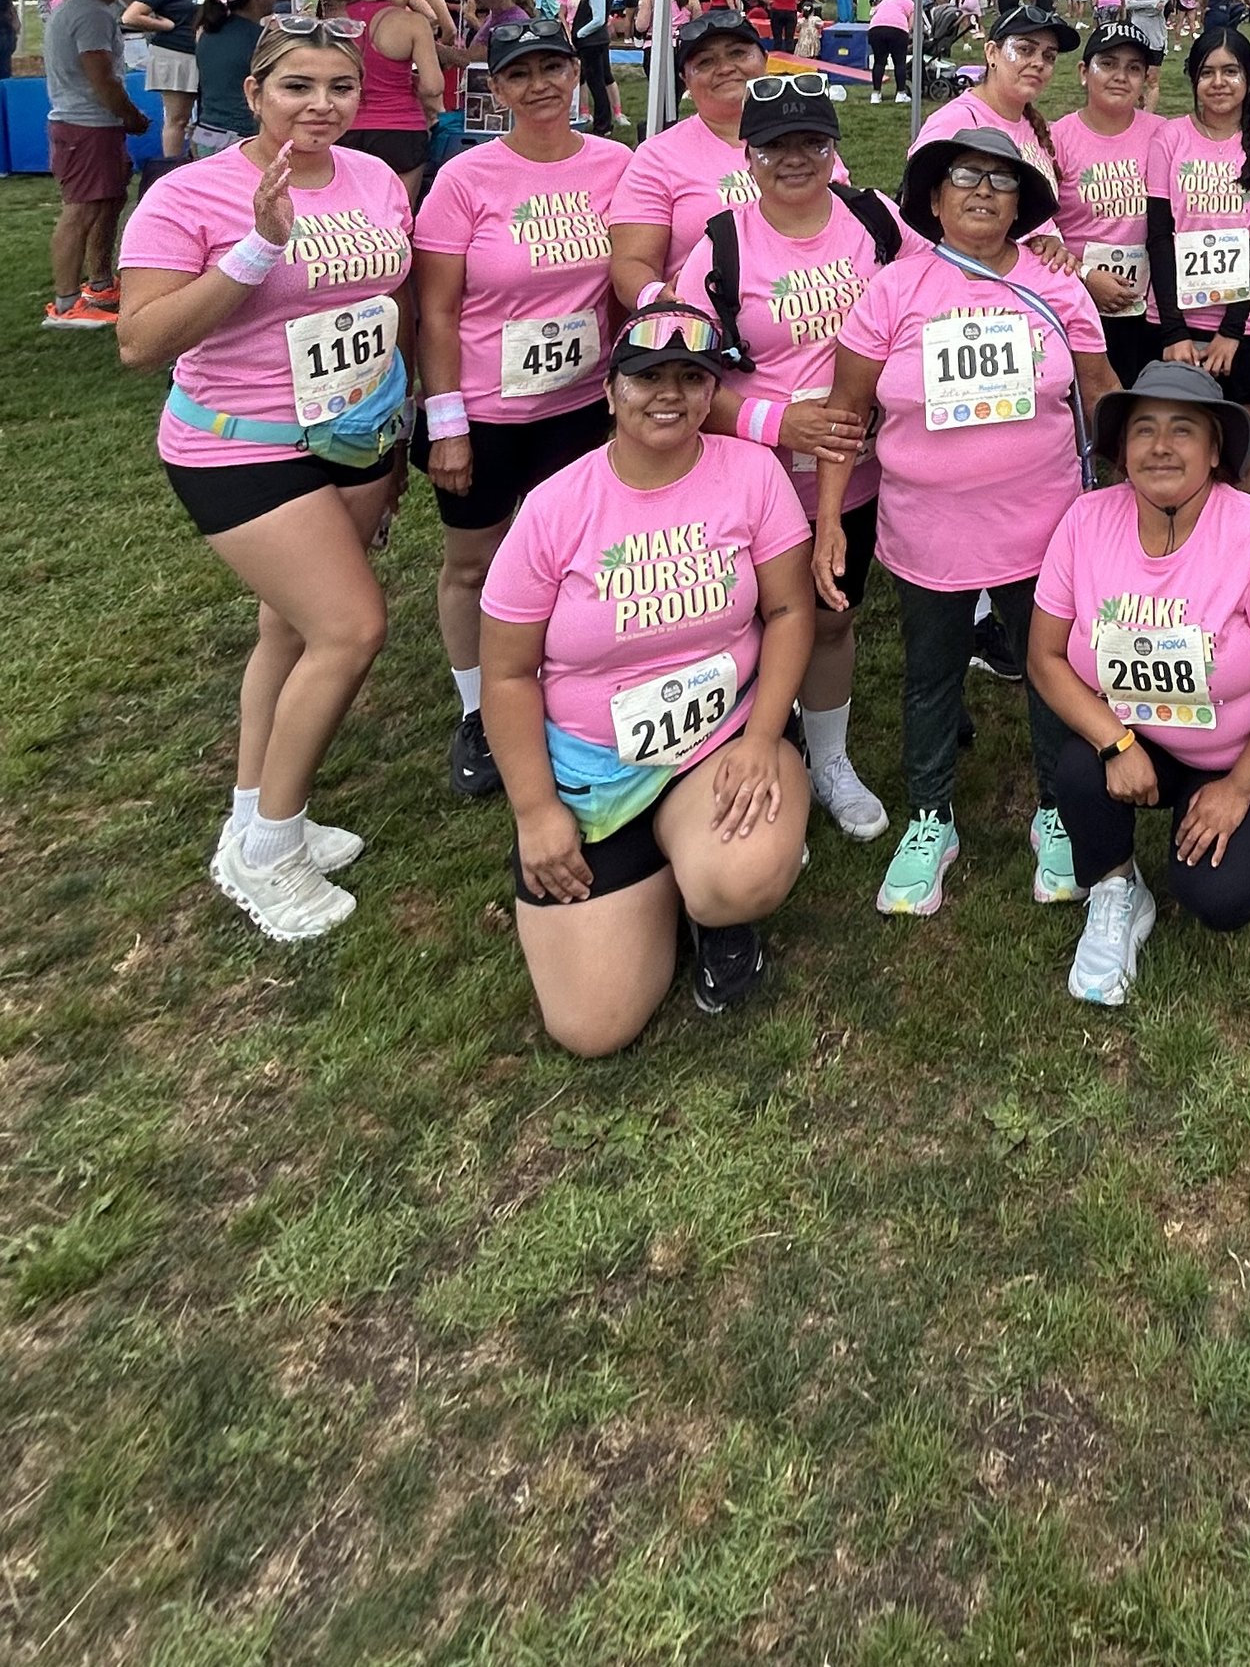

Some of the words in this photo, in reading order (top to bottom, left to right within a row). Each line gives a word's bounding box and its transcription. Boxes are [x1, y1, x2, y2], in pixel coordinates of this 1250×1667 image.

[1092, 158, 1139, 181] MAKE
[529, 190, 593, 218] MAKE
[1076, 177, 1149, 204] YOURSEL
[296, 208, 376, 236] MAKE
[508, 213, 610, 246] YOURSEL
[788, 256, 858, 292] MAKE
[1184, 248, 1241, 277] 2137
[357, 305, 385, 321] HOKA
[563, 319, 587, 332] HOKA
[790, 312, 844, 346] PRO
[985, 324, 1014, 334] HOKA
[306, 324, 386, 379] 1161
[522, 337, 583, 375] 454
[937, 342, 1019, 382] 1081
[624, 522, 709, 565] MAKE
[594, 545, 741, 603] YOURSELF
[615, 580, 736, 634] PROUD.
[1117, 591, 1190, 629] MAKE
[1156, 638, 1188, 651] HOKA
[688, 667, 721, 690] HOKA
[1108, 659, 1196, 694] 2698
[631, 687, 726, 762] 2143
